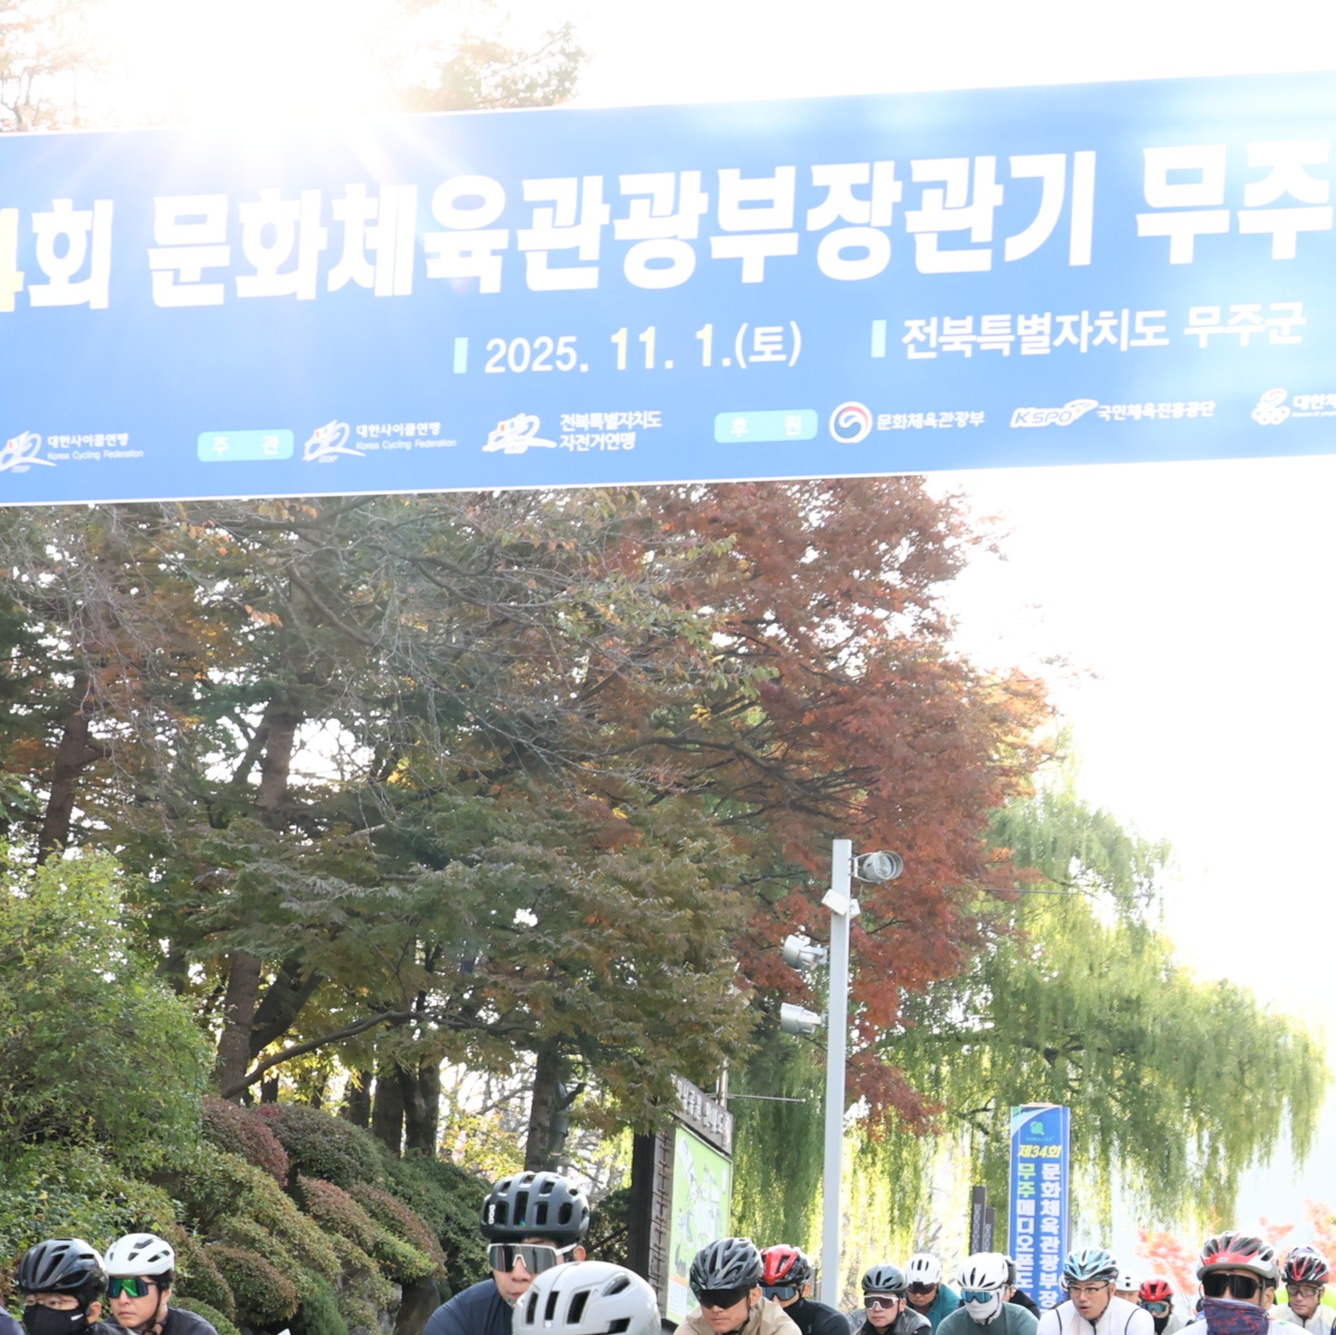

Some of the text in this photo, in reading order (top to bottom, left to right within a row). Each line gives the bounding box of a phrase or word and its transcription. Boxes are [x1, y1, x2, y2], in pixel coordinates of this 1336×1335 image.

[148, 150, 1097, 308] 문화체육관광부장관기
[900, 301, 1307, 360] 전북특별자치도 무주군
[484, 335, 589, 375] 2025.
[610, 326, 674, 371] 11.
[559, 411, 663, 431] 전북특별자치도
[876, 409, 986, 431] 문화체육관광부
[1011, 408, 1074, 426] KSPO
[1096, 399, 1217, 423] 국민체육진흥공단
[47, 432, 129, 449] 대한사이클연맹
[355, 421, 441, 439] 대한사이클연맹
[355, 437, 457, 451] Korea Cycling Federation
[558, 431, 636, 453] 자전거연맹
[47, 447, 144, 462] Korea Cycling Federation
[1017, 1144, 1062, 1160] 제34회
[1038, 1163, 1062, 1313] 문화체육관광부장
